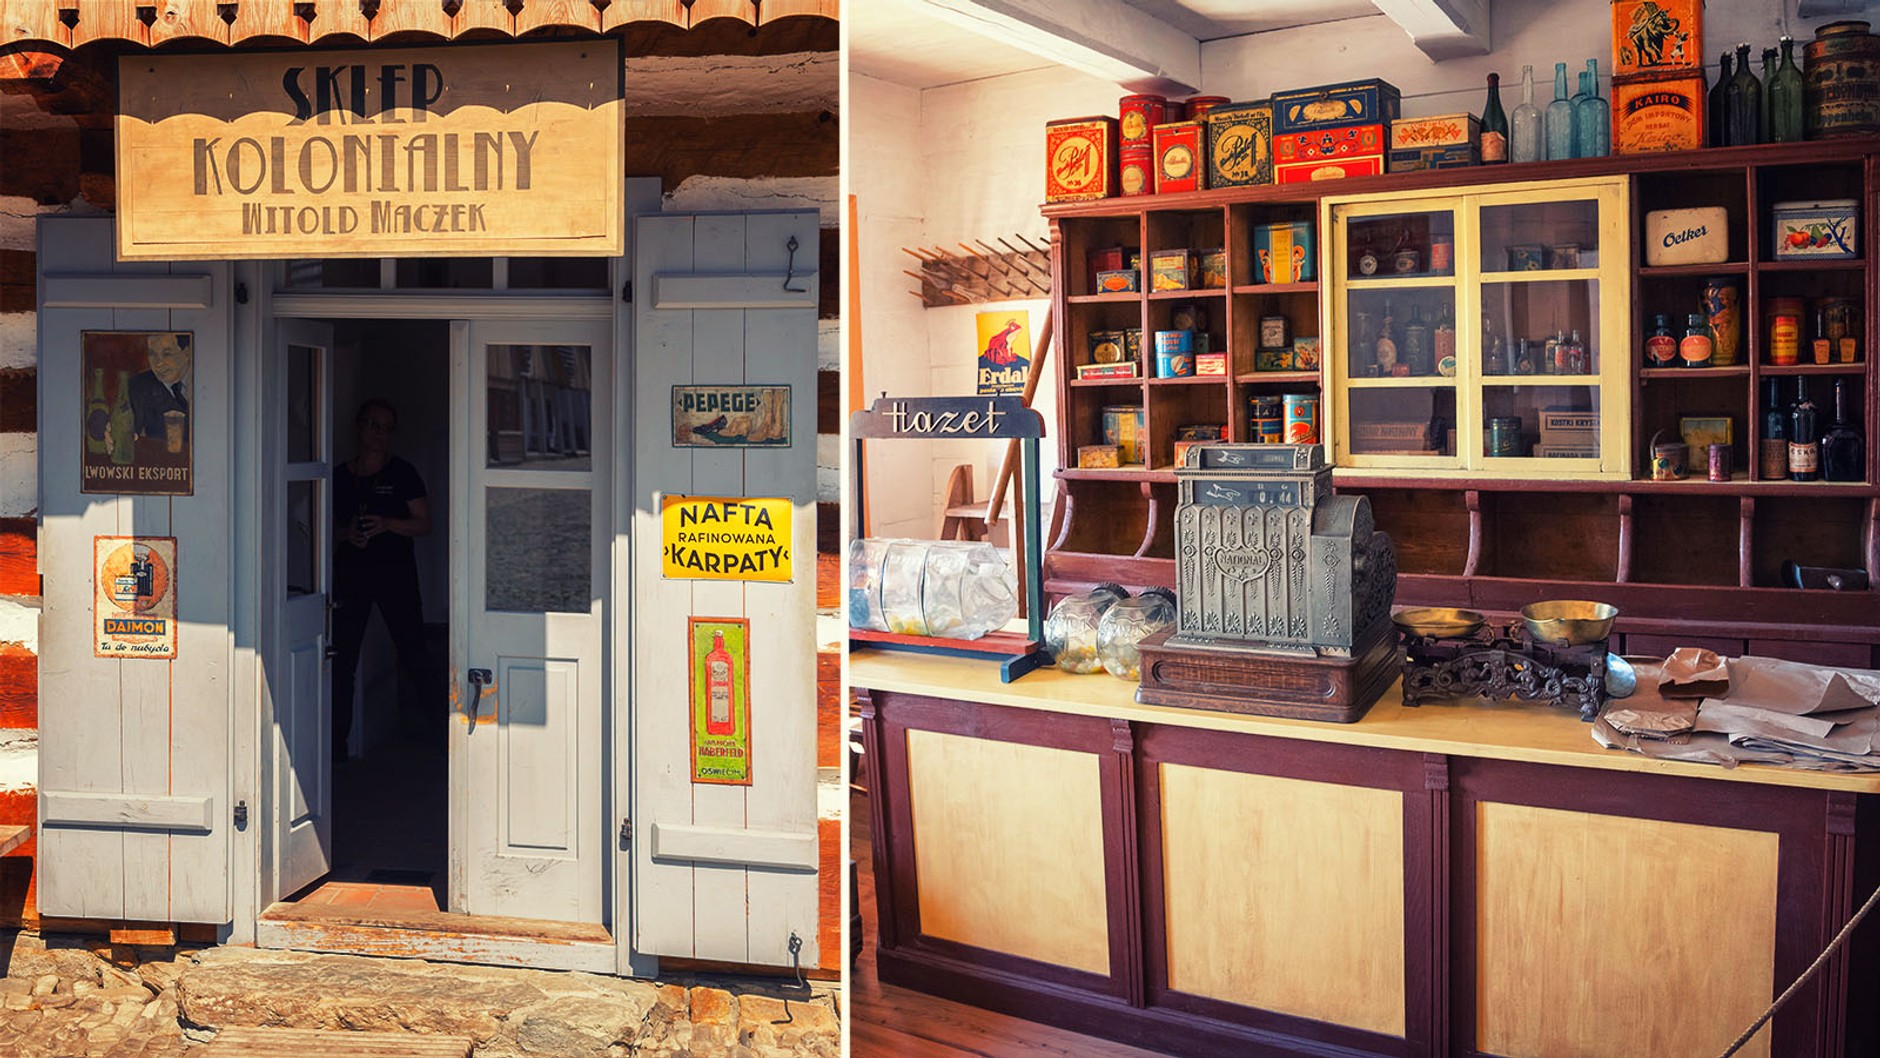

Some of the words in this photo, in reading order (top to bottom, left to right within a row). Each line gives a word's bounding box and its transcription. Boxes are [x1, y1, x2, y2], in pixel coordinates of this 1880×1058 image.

[283, 63, 443, 126] SKLEP
[1635, 94, 1680, 109] KAIRO
[193, 130, 539, 196] KOLONIALNY
[242, 203, 359, 235] WITOLD
[1663, 225, 1709, 248] Oetker
[979, 366, 1028, 386] Erdal
[683, 392, 756, 412] PEPEGE
[882, 400, 1007, 434] Hazet
[85, 465, 134, 480] LWOWSKI
[138, 466, 188, 480] EKSPORT
[680, 502, 774, 531] NAFTA
[678, 532, 776, 545] RAFINOWANA
[1219, 552, 1264, 566] NATIONAL
[106, 620, 164, 634] DAIMON
[698, 746, 744, 758] HABERFELD
